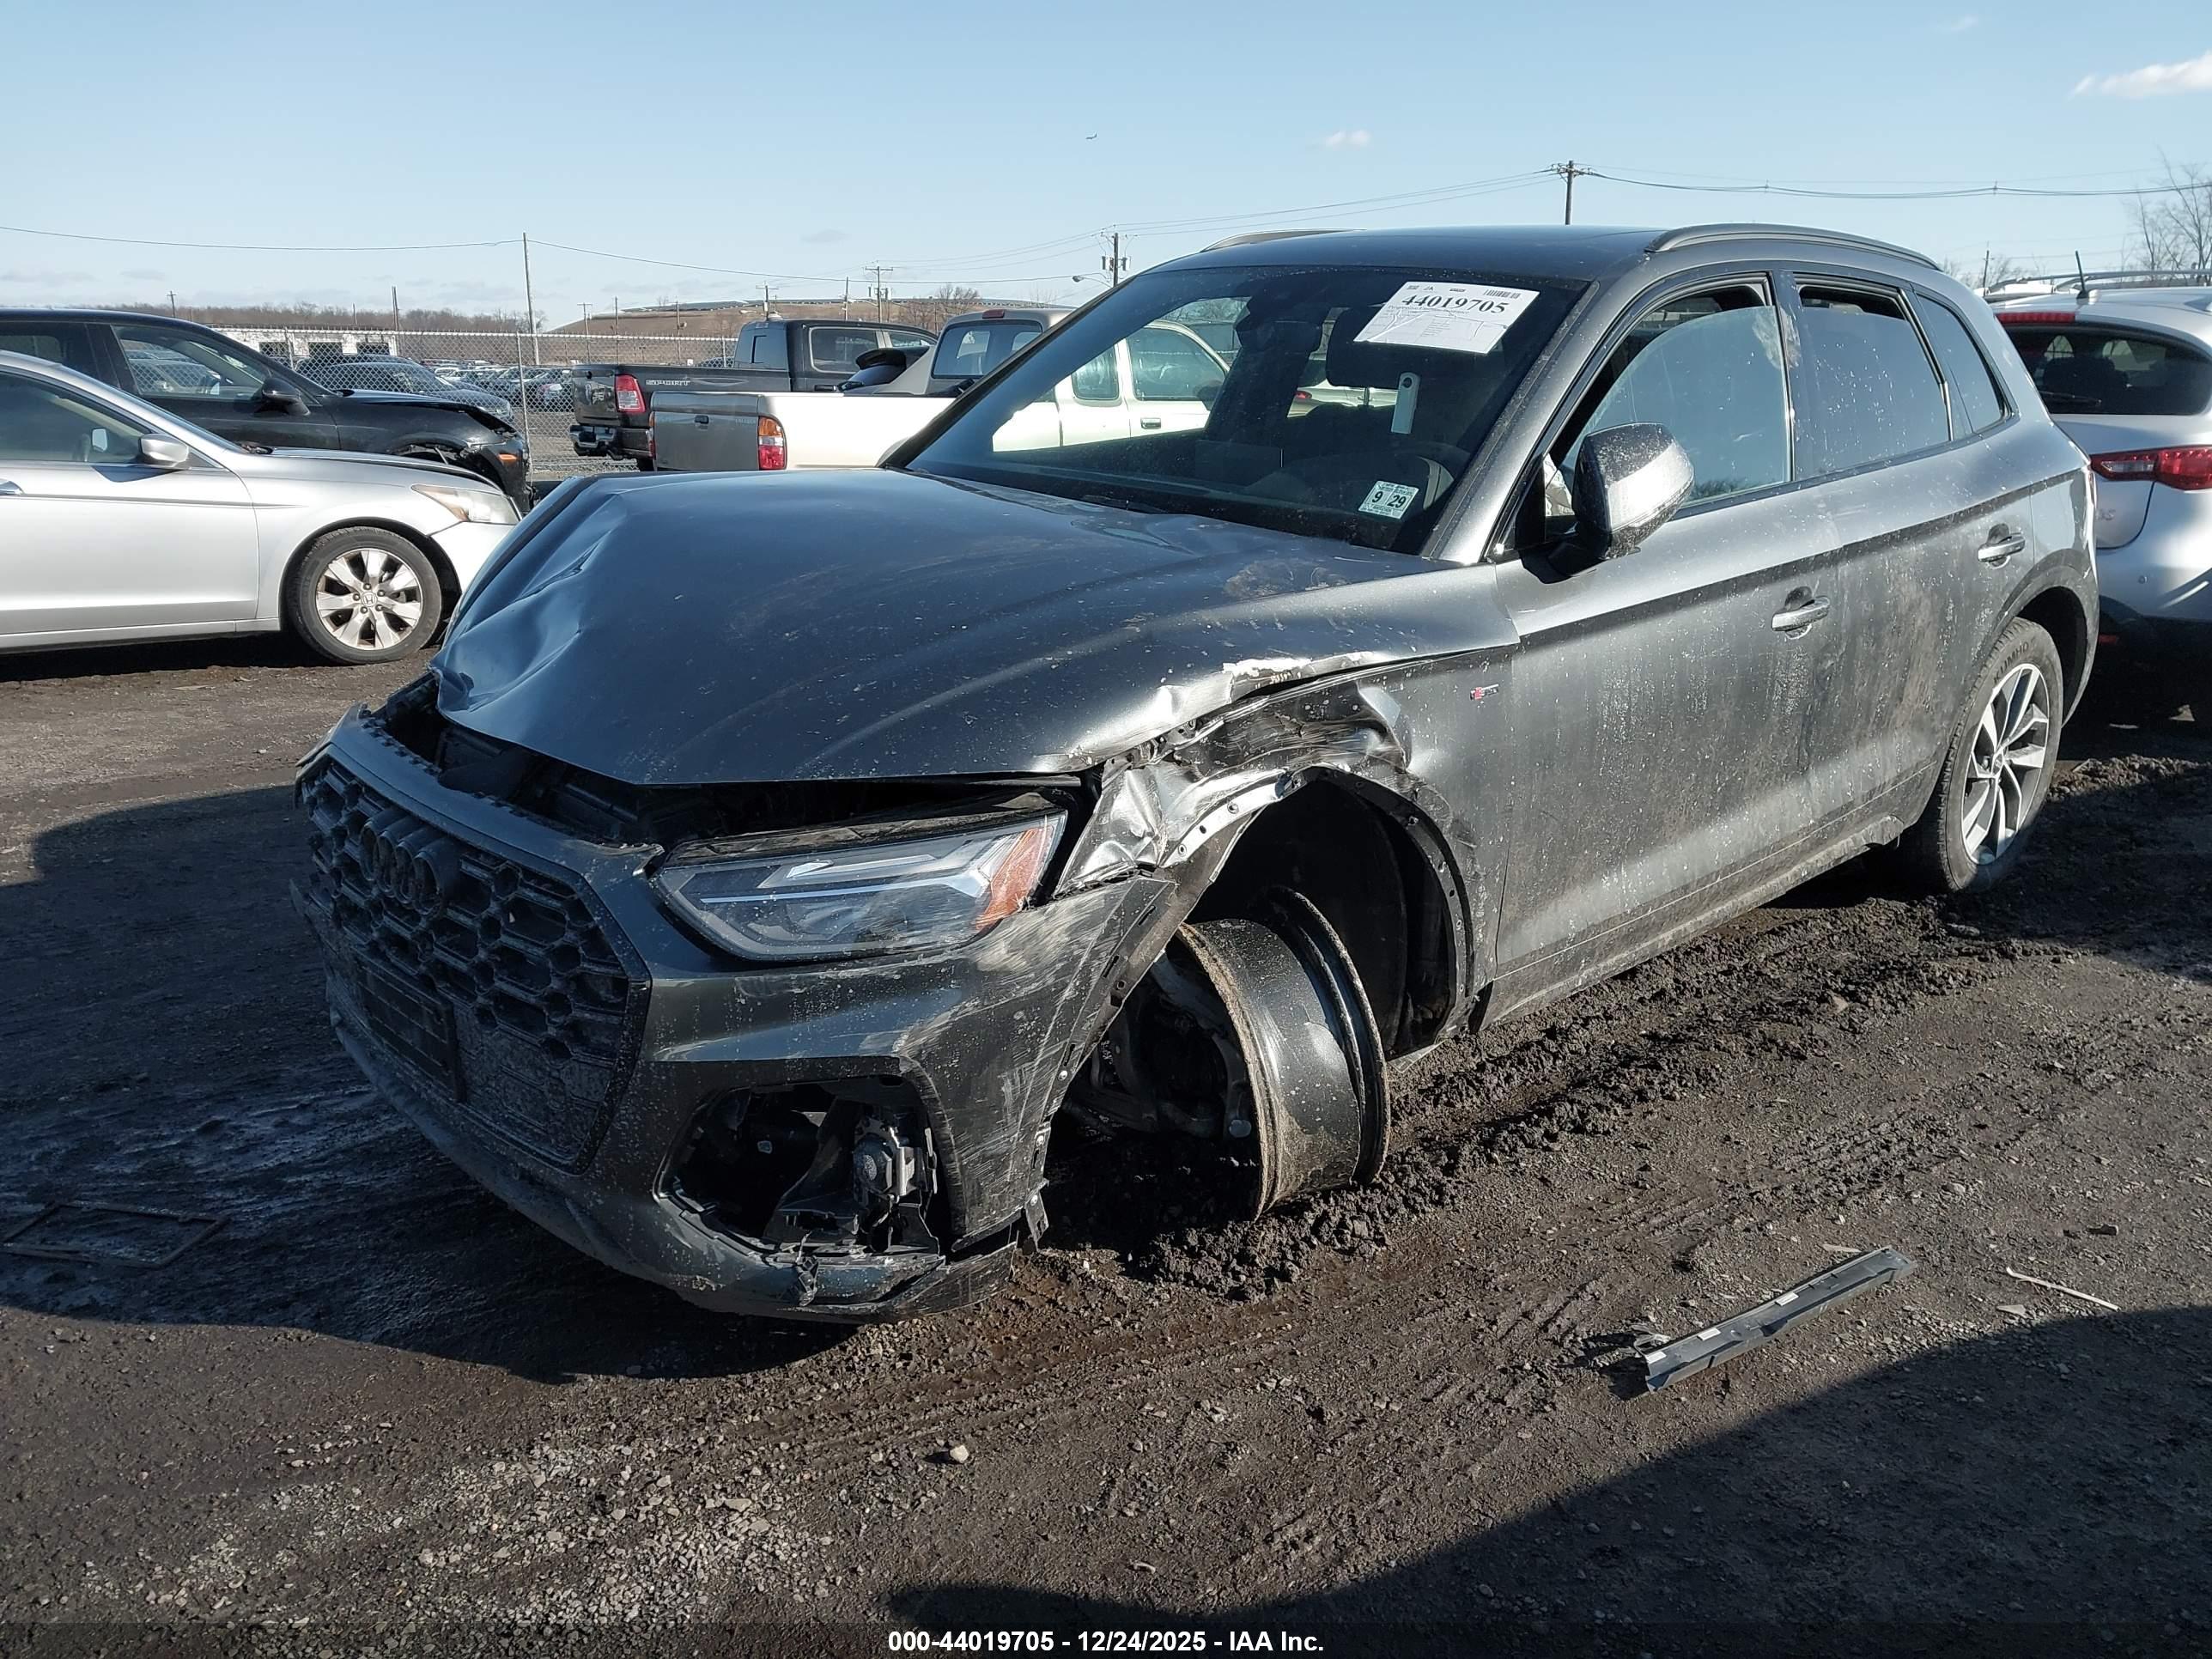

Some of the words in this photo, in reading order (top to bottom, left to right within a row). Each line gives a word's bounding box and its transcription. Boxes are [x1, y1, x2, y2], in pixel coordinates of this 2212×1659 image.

[1402, 295, 1510, 313] 44019705
[1371, 491, 1383, 503] 9
[1387, 495, 1407, 508] 29
